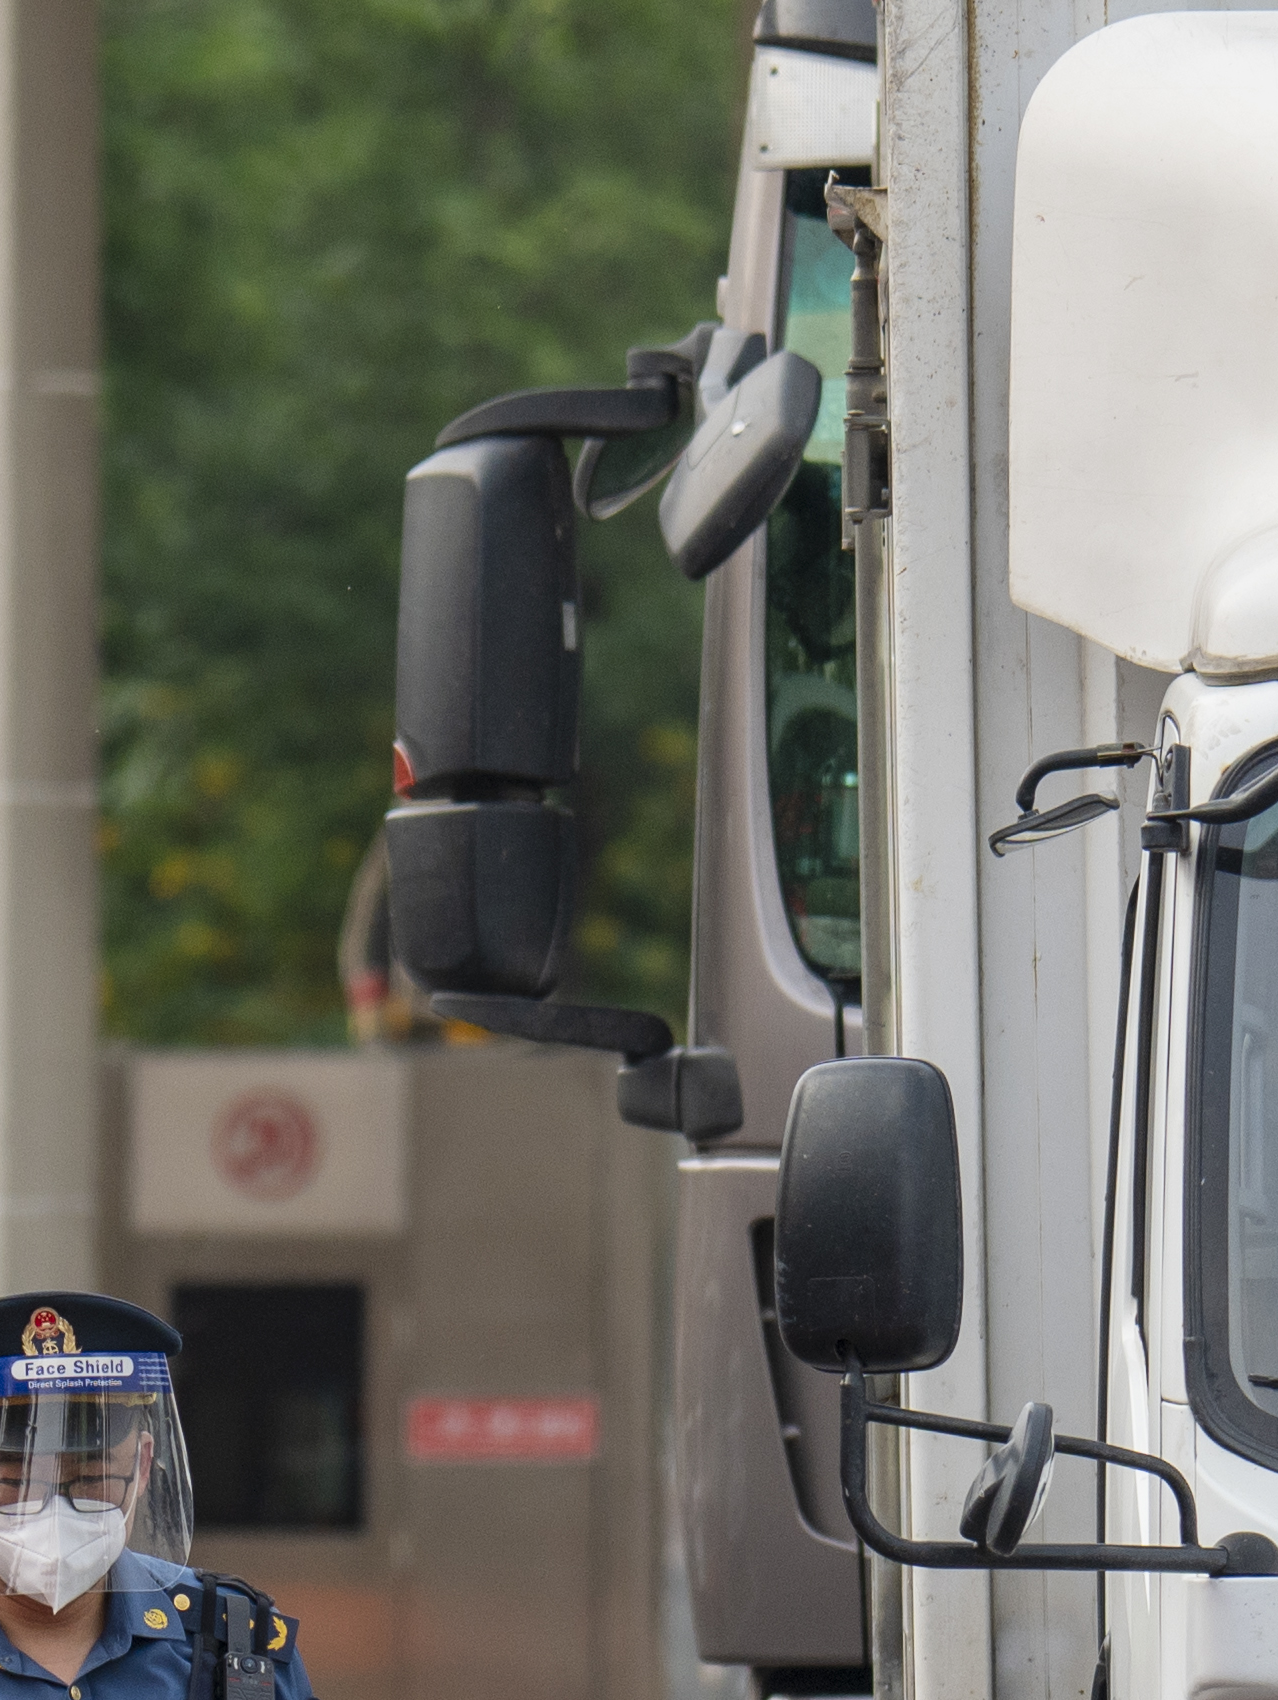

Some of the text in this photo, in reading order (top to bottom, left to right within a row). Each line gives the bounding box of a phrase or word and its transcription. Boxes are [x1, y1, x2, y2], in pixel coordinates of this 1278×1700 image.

[25, 1362, 66, 1377] Face
[73, 1359, 124, 1375] Shield
[28, 1380, 54, 1390] Direct
[56, 1379, 84, 1388] Splash
